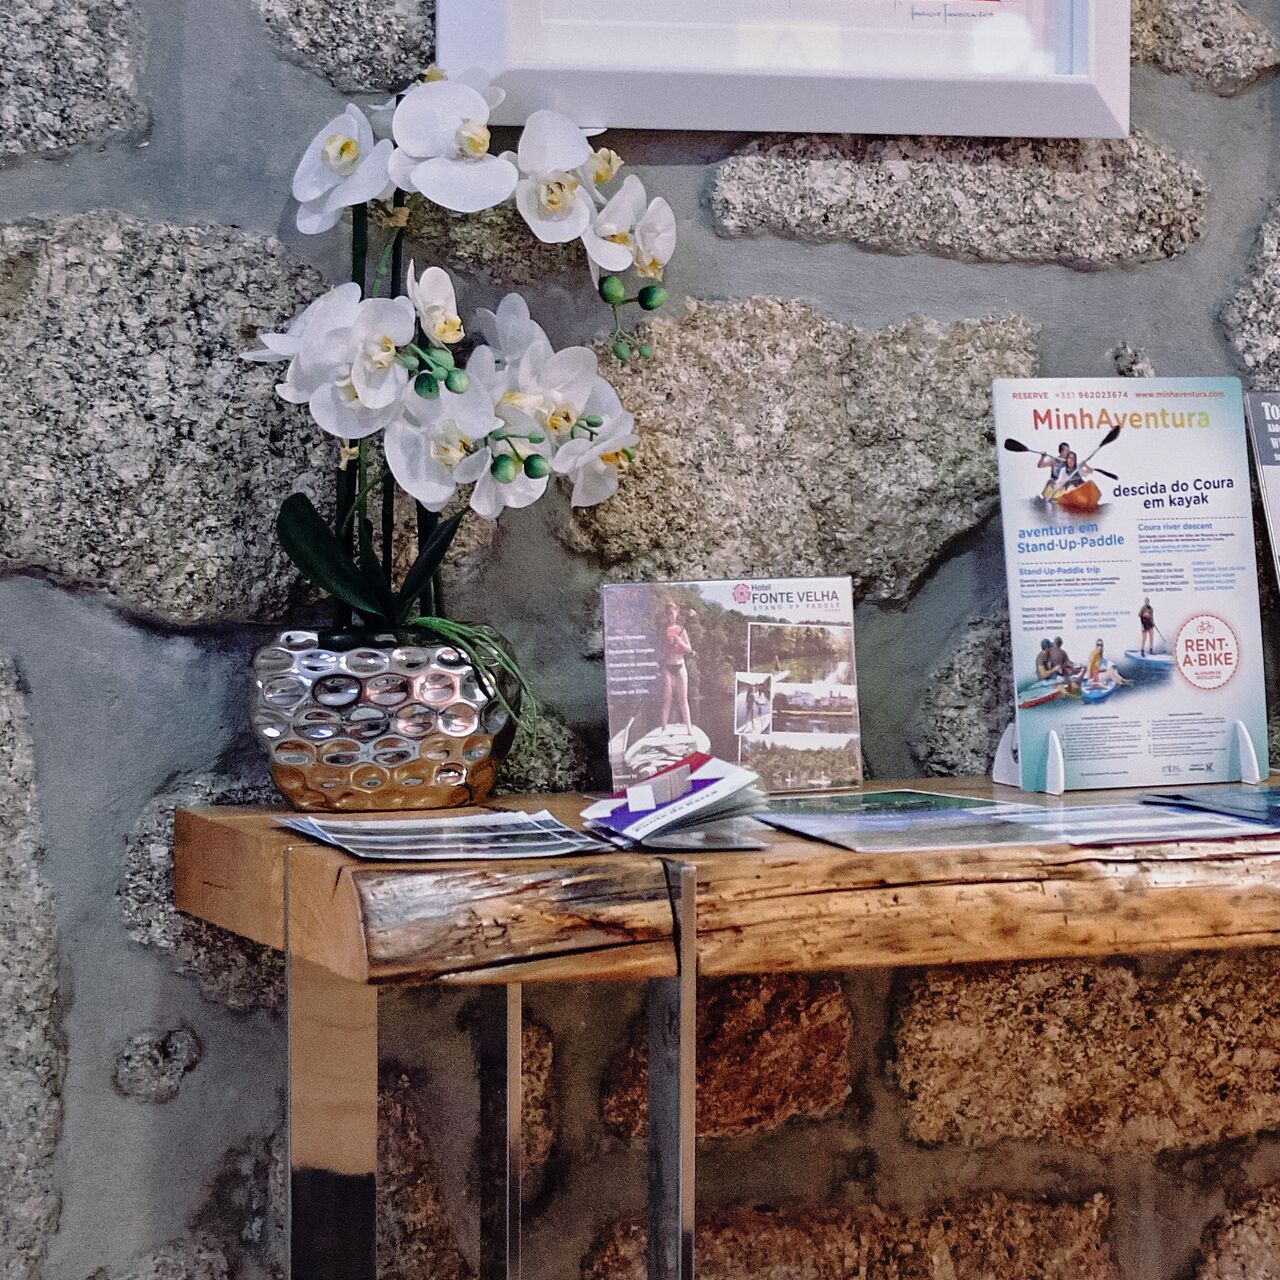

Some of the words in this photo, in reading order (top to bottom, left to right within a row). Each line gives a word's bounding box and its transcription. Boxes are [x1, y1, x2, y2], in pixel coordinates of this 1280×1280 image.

[1012, 392, 1048, 400] RESERVE
[1032, 407, 1211, 431] MinhAventura
[1113, 481, 1167, 498] descida
[1171, 479, 1189, 493] do
[1193, 478, 1234, 491] Coura
[1143, 498, 1165, 509] em
[1168, 492, 1209, 509] kayak
[1018, 524, 1075, 539] aventura
[1079, 522, 1099, 534] em
[1137, 523, 1161, 531] Coura
[1163, 522, 1180, 531] river
[1183, 522, 1213, 530] descent
[1086, 566, 1101, 575] trip
[751, 583, 772, 592] Hotel
[752, 591, 794, 604] FONTE
[797, 590, 839, 603] VELHA
